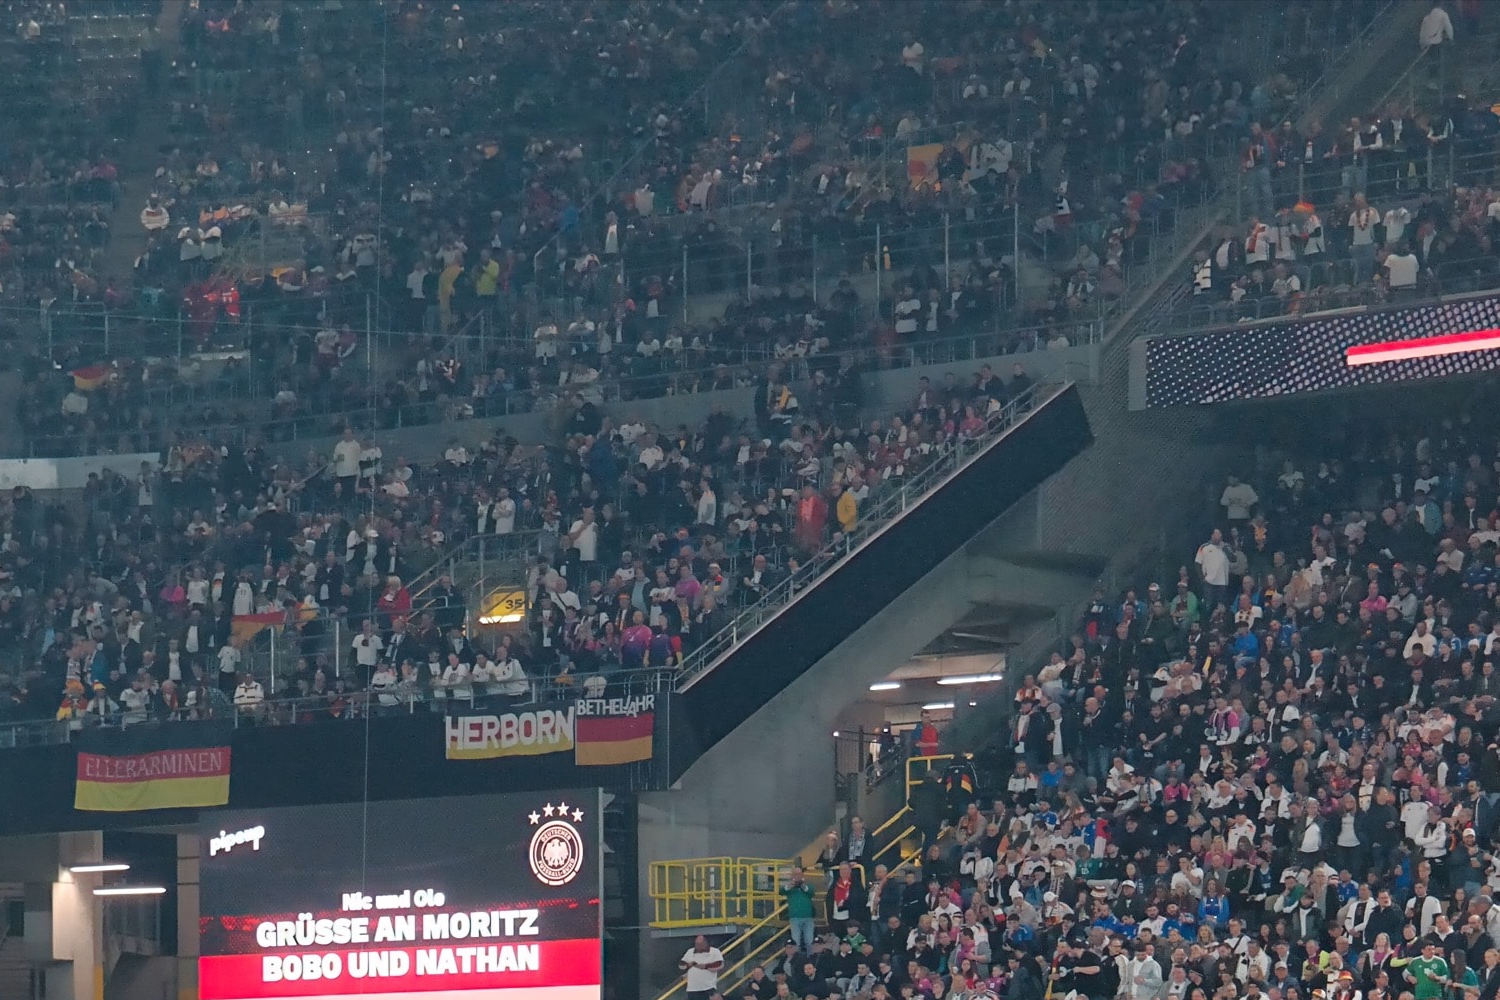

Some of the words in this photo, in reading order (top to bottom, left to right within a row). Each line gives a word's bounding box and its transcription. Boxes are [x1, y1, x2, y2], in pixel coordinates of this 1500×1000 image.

[446, 707, 575, 750] HERBORN
[256, 912, 370, 947] GRÜSSE
[374, 917, 416, 941] AN
[423, 909, 539, 940] MORITZ
[262, 953, 342, 983] BOBO
[347, 950, 410, 979] UND
[416, 944, 539, 976] NATHAN
